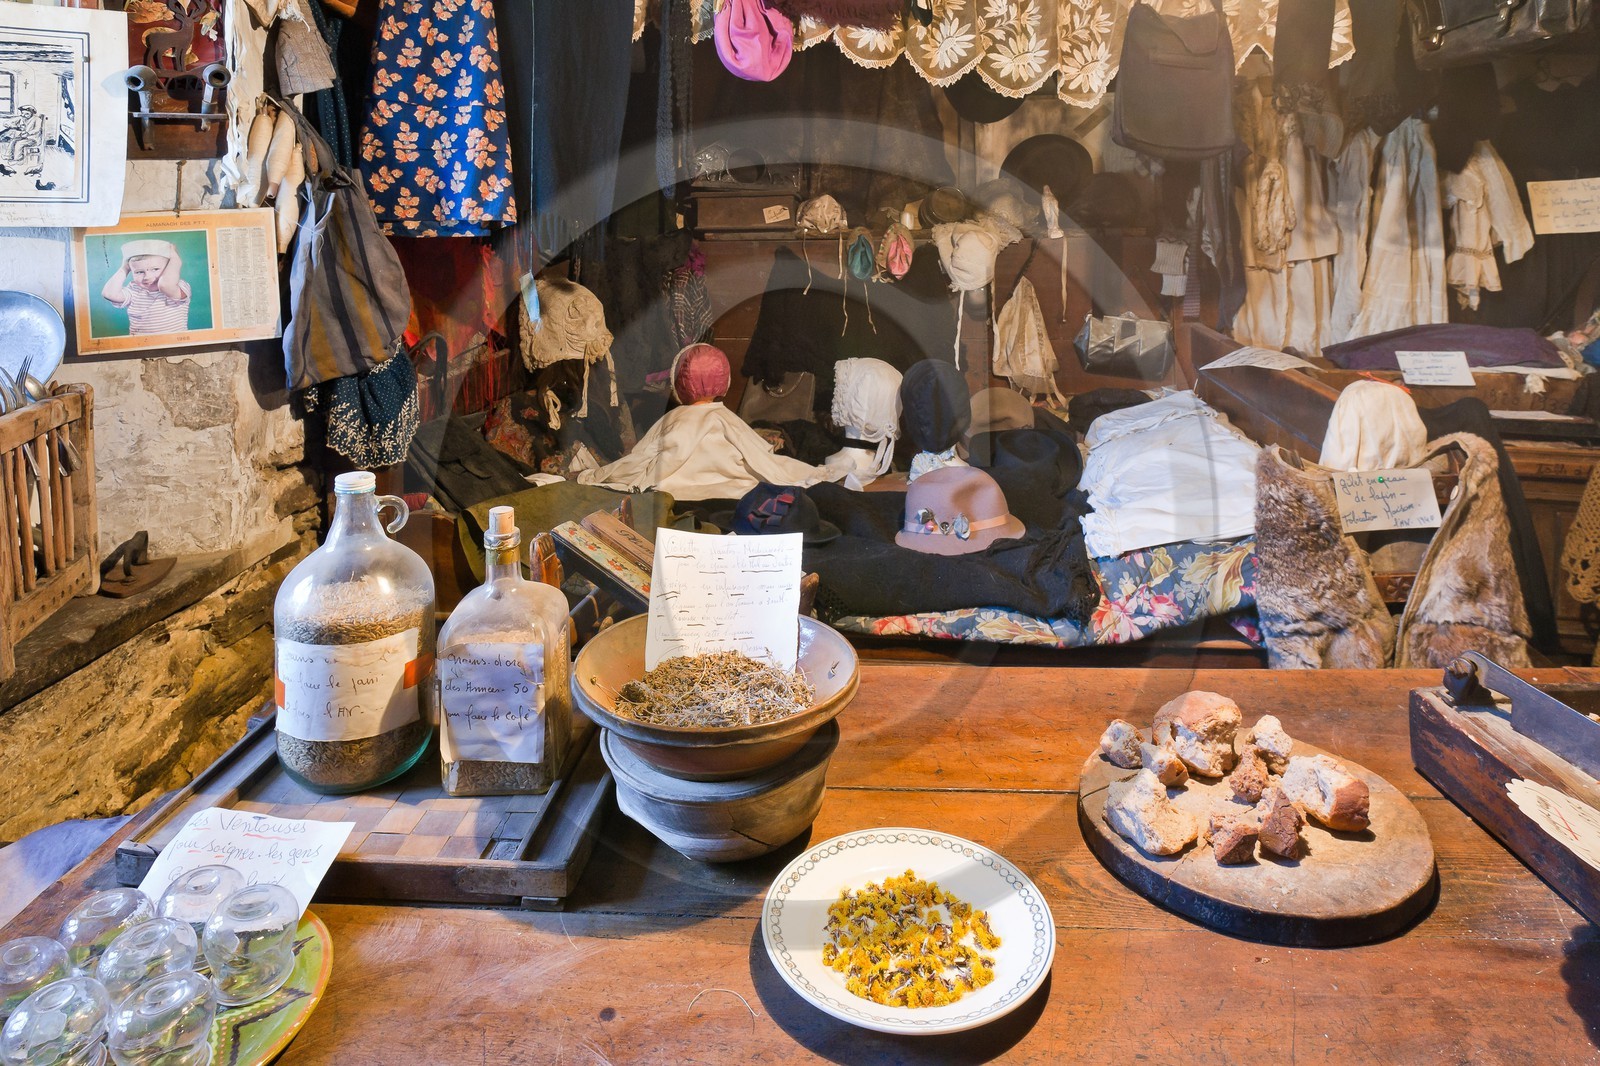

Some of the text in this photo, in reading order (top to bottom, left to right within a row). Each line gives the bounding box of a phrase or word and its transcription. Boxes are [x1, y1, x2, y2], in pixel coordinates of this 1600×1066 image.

[1354, 491, 1365, 503] de
[513, 682, 529, 694] 50
[219, 812, 307, 835] Ventouses
[288, 845, 325, 866] gens
